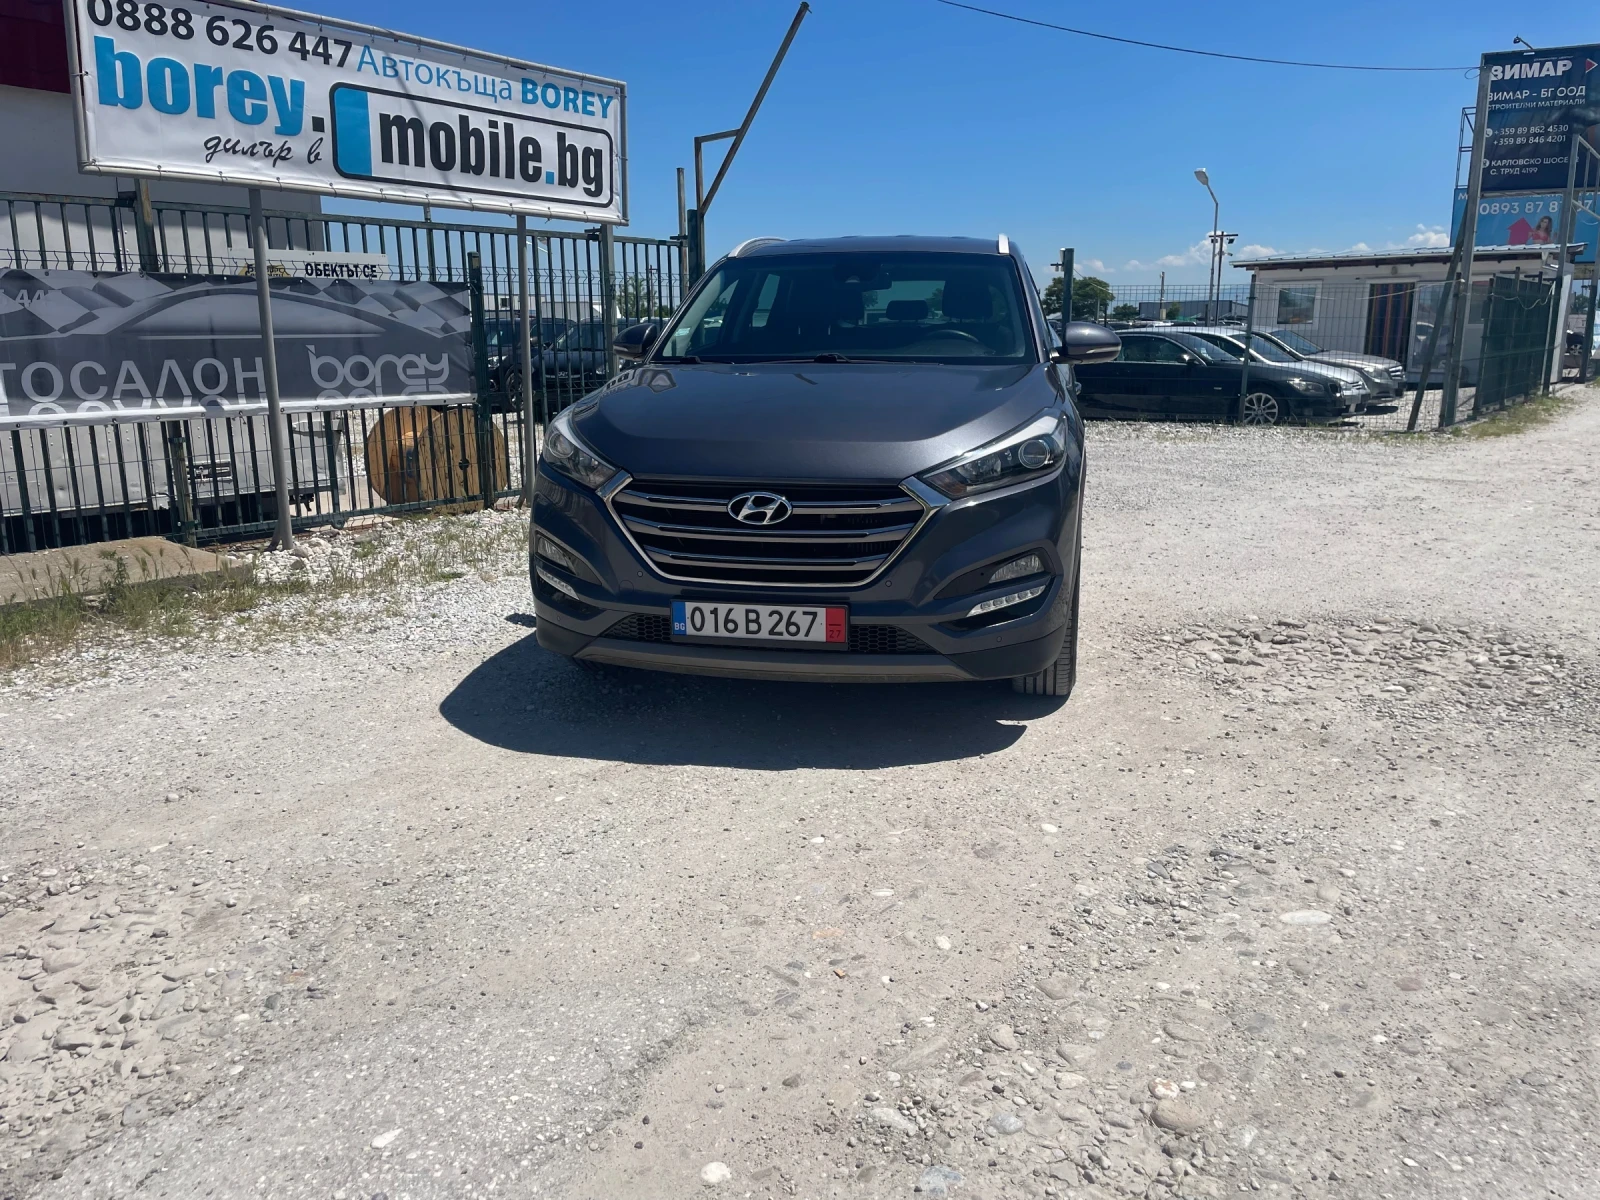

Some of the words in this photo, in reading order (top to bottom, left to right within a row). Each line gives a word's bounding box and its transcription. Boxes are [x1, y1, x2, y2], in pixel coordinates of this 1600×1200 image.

[87, 0, 194, 40] 0888
[205, 16, 278, 54] 626
[288, 31, 352, 68] 447
[1490, 60, 1572, 80] ВИМАР
[521, 77, 613, 118] BOREY
[1488, 90, 1530, 101] ВИМАР
[1541, 88, 1555, 98] БГ
[1557, 86, 1586, 97] ООД
[1538, 99, 1586, 107] МАТЕРИАЛИ
[1494, 127, 1515, 135] +359
[1493, 137, 1514, 145] +359
[204, 135, 293, 167] дилър
[379, 112, 603, 197] mobile.bg
[1491, 158, 1542, 167] КАРЛОВСКО
[1500, 167, 1520, 175] ТРУД
[1480, 202, 1519, 214] 0893
[1525, 202, 1543, 212] 87
[362, 265, 377, 278] СЕ
[306, 345, 449, 388] borey
[674, 622, 686, 631] BG
[829, 629, 842, 639] 27
